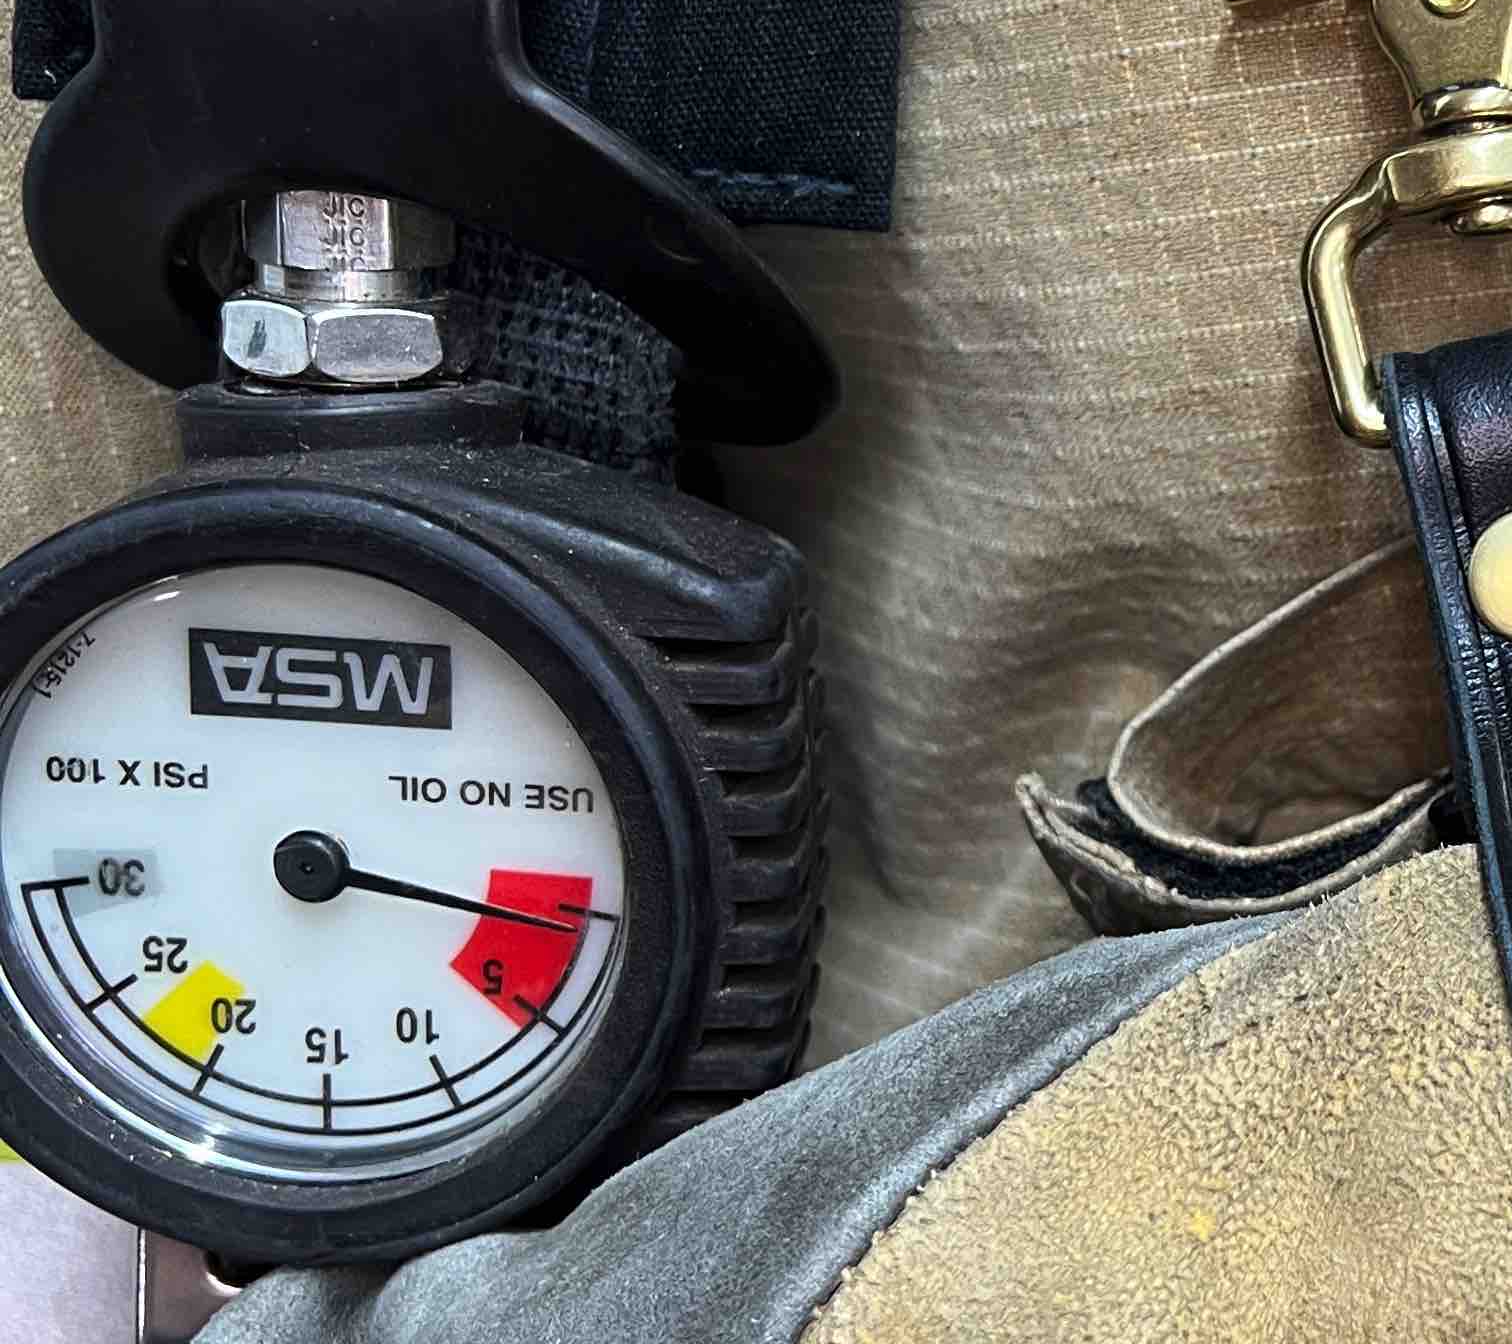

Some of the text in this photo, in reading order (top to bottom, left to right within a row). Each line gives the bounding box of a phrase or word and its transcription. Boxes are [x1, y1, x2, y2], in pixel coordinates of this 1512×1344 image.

[202, 641, 435, 716] MSA
[45, 755, 209, 790] PSI X 100
[387, 775, 594, 813] USE NO OIL
[99, 857, 146, 897] 30
[142, 935, 188, 973] 25
[482, 958, 504, 995] 5
[210, 997, 257, 1035] 20
[395, 1006, 440, 1045] 10
[304, 1026, 349, 1065] 15
